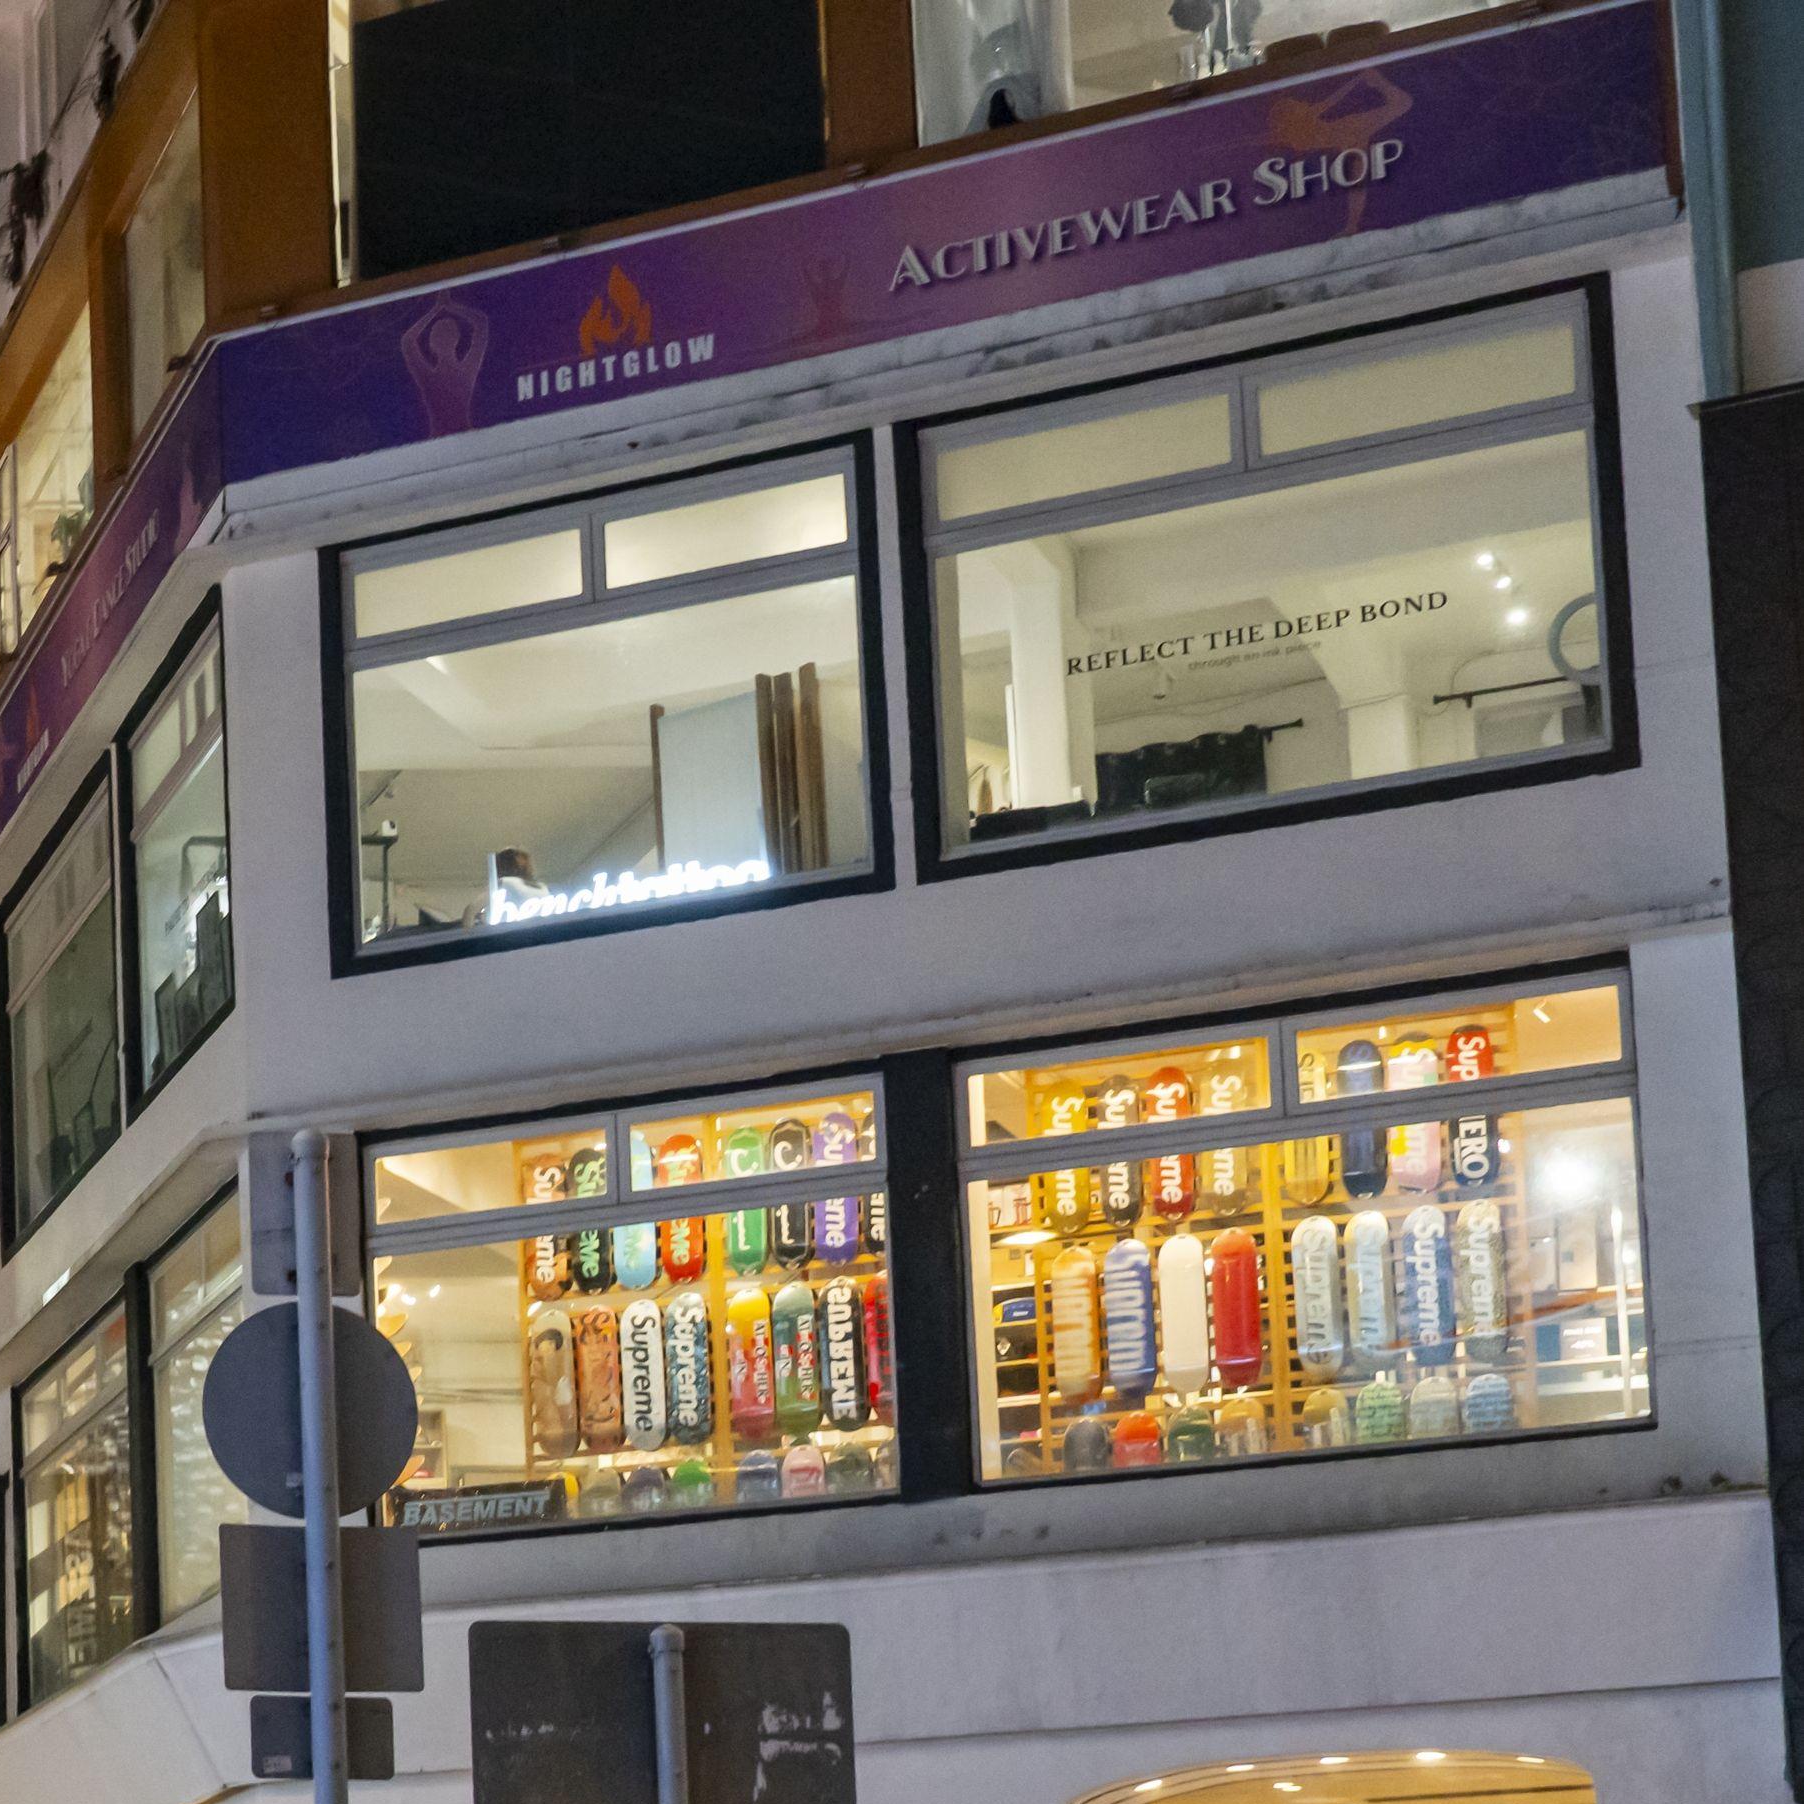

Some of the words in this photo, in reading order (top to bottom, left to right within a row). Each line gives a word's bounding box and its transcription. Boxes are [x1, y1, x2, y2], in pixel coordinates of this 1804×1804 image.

[889, 178, 1236, 292] ACTIVEWEAR
[1253, 138, 1403, 206] SHOP
[516, 335, 716, 402] NIGHTGLOW
[1066, 635, 1195, 677] REFLECT
[1203, 624, 1265, 652] THE
[1274, 608, 1351, 641] DEEP
[1360, 591, 1448, 625] BOND
[1302, 1229, 1330, 1365] Supreme
[1405, 1221, 1446, 1346] Supreme
[630, 1313, 657, 1433] Supreme
[673, 1305, 703, 1427] Supreme
[403, 1494, 549, 1527] BASEMENT
